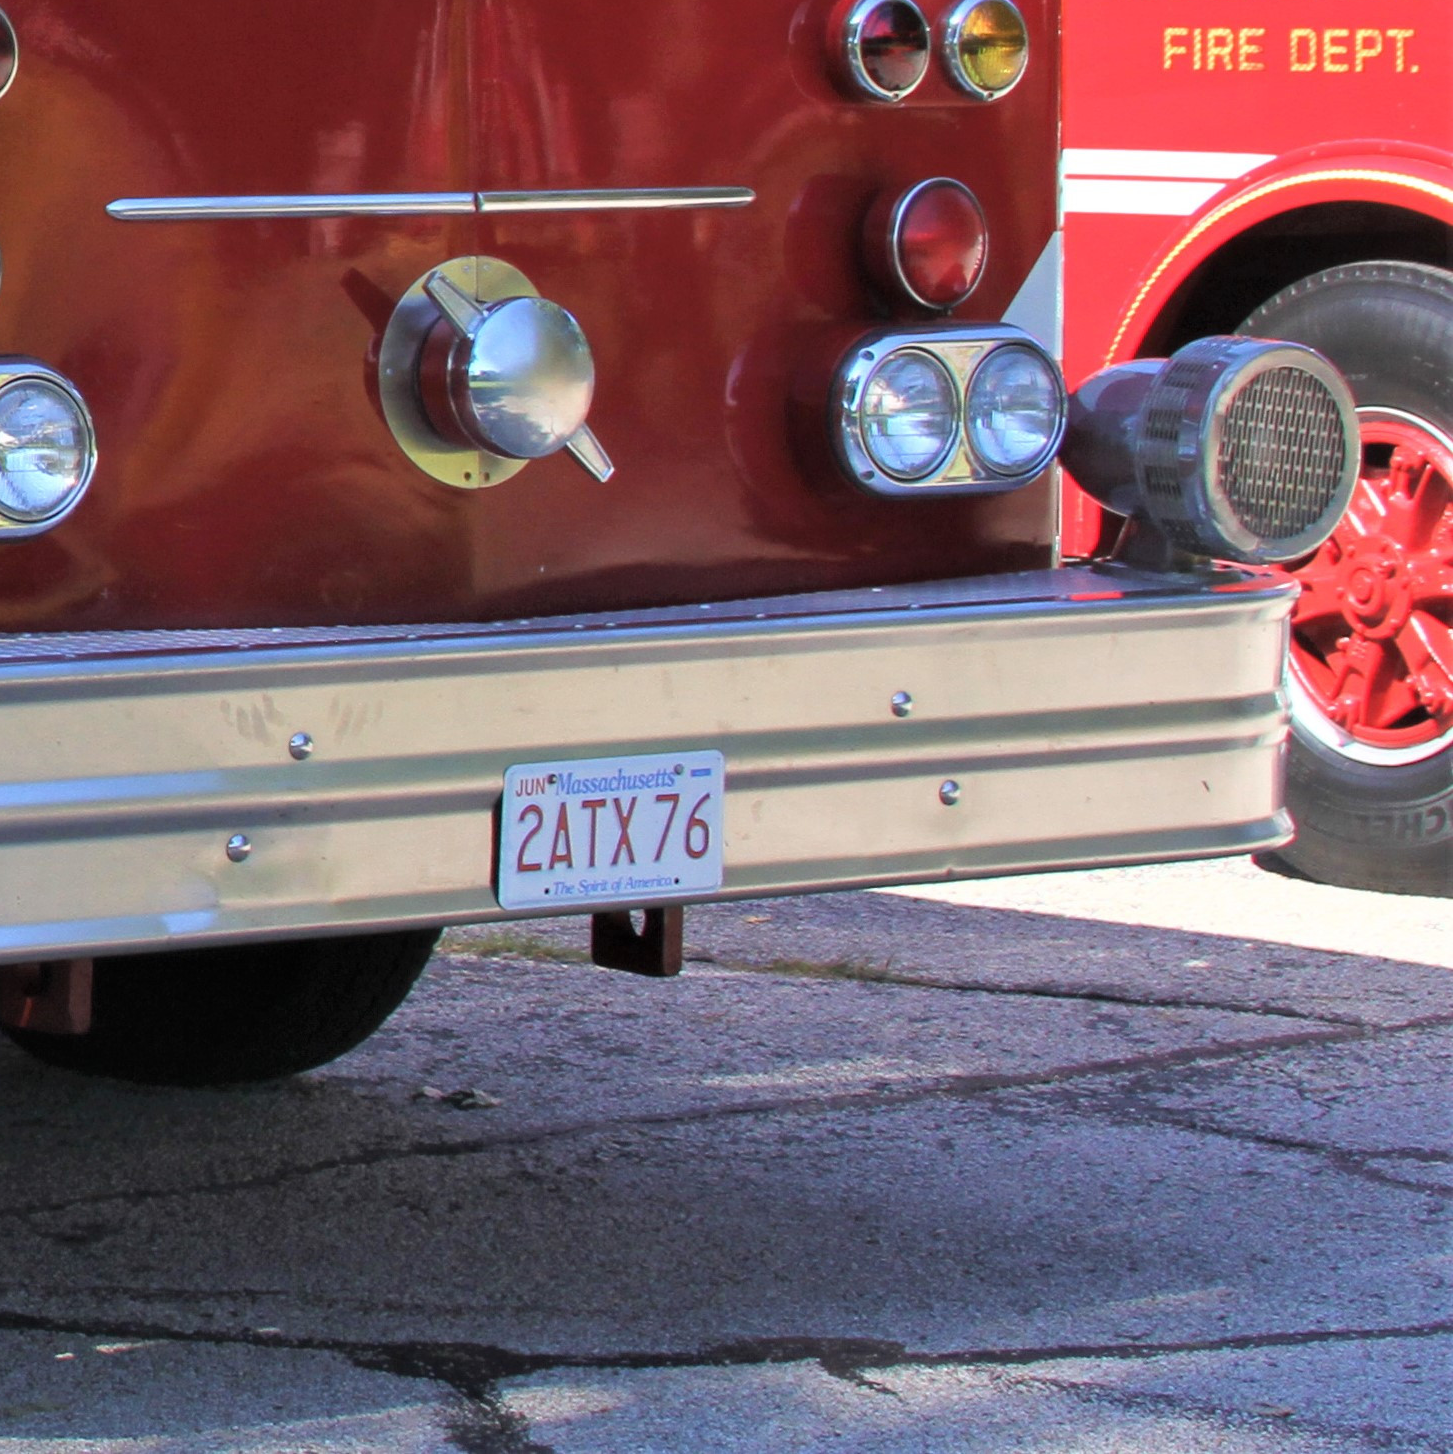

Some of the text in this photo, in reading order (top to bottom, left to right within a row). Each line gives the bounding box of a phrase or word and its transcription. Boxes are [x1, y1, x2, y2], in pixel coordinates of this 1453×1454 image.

[1163, 27, 1420, 74] FIRE DEPT.
[515, 768, 676, 797] JUN Massachusetts
[553, 874, 672, 896] The Spirit of America
